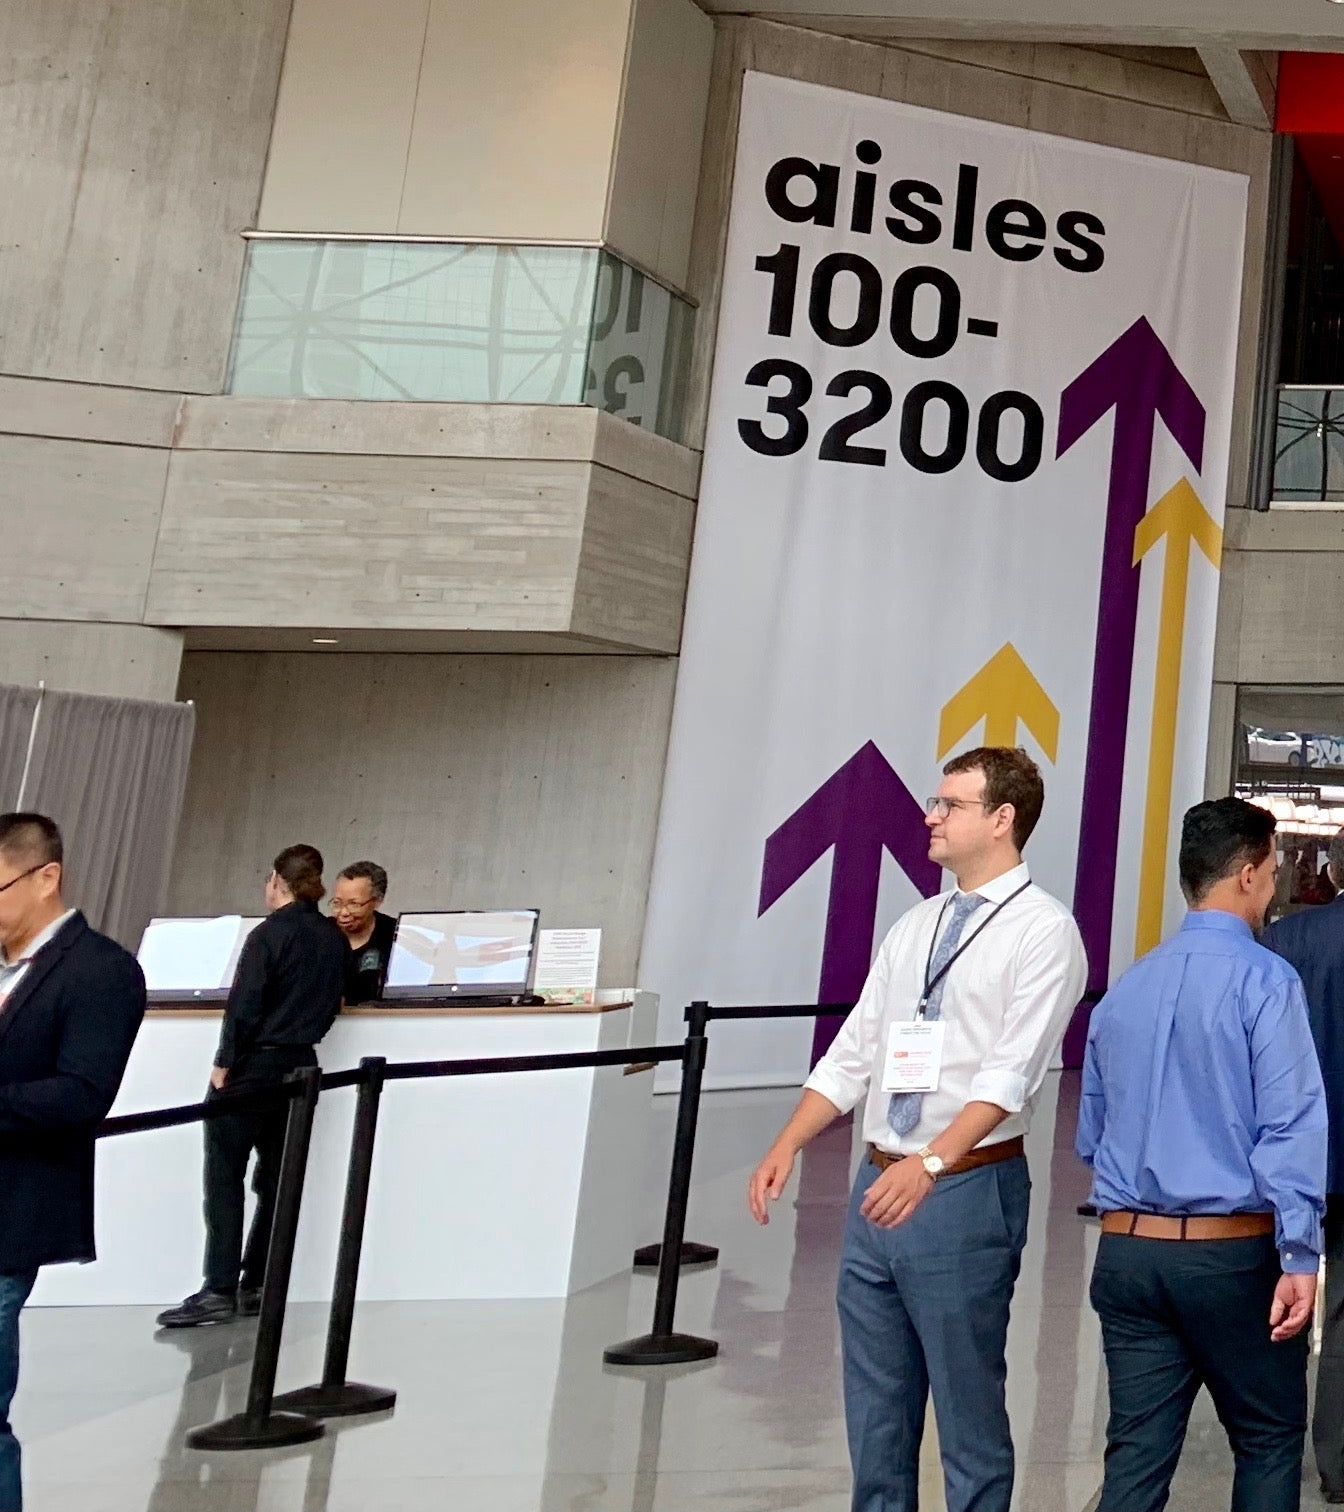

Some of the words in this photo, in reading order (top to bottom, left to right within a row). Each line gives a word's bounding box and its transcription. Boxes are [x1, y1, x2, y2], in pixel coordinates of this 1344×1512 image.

[764, 139, 1106, 273] aisles
[754, 242, 999, 359] 100-
[737, 358, 1044, 483] 3200
